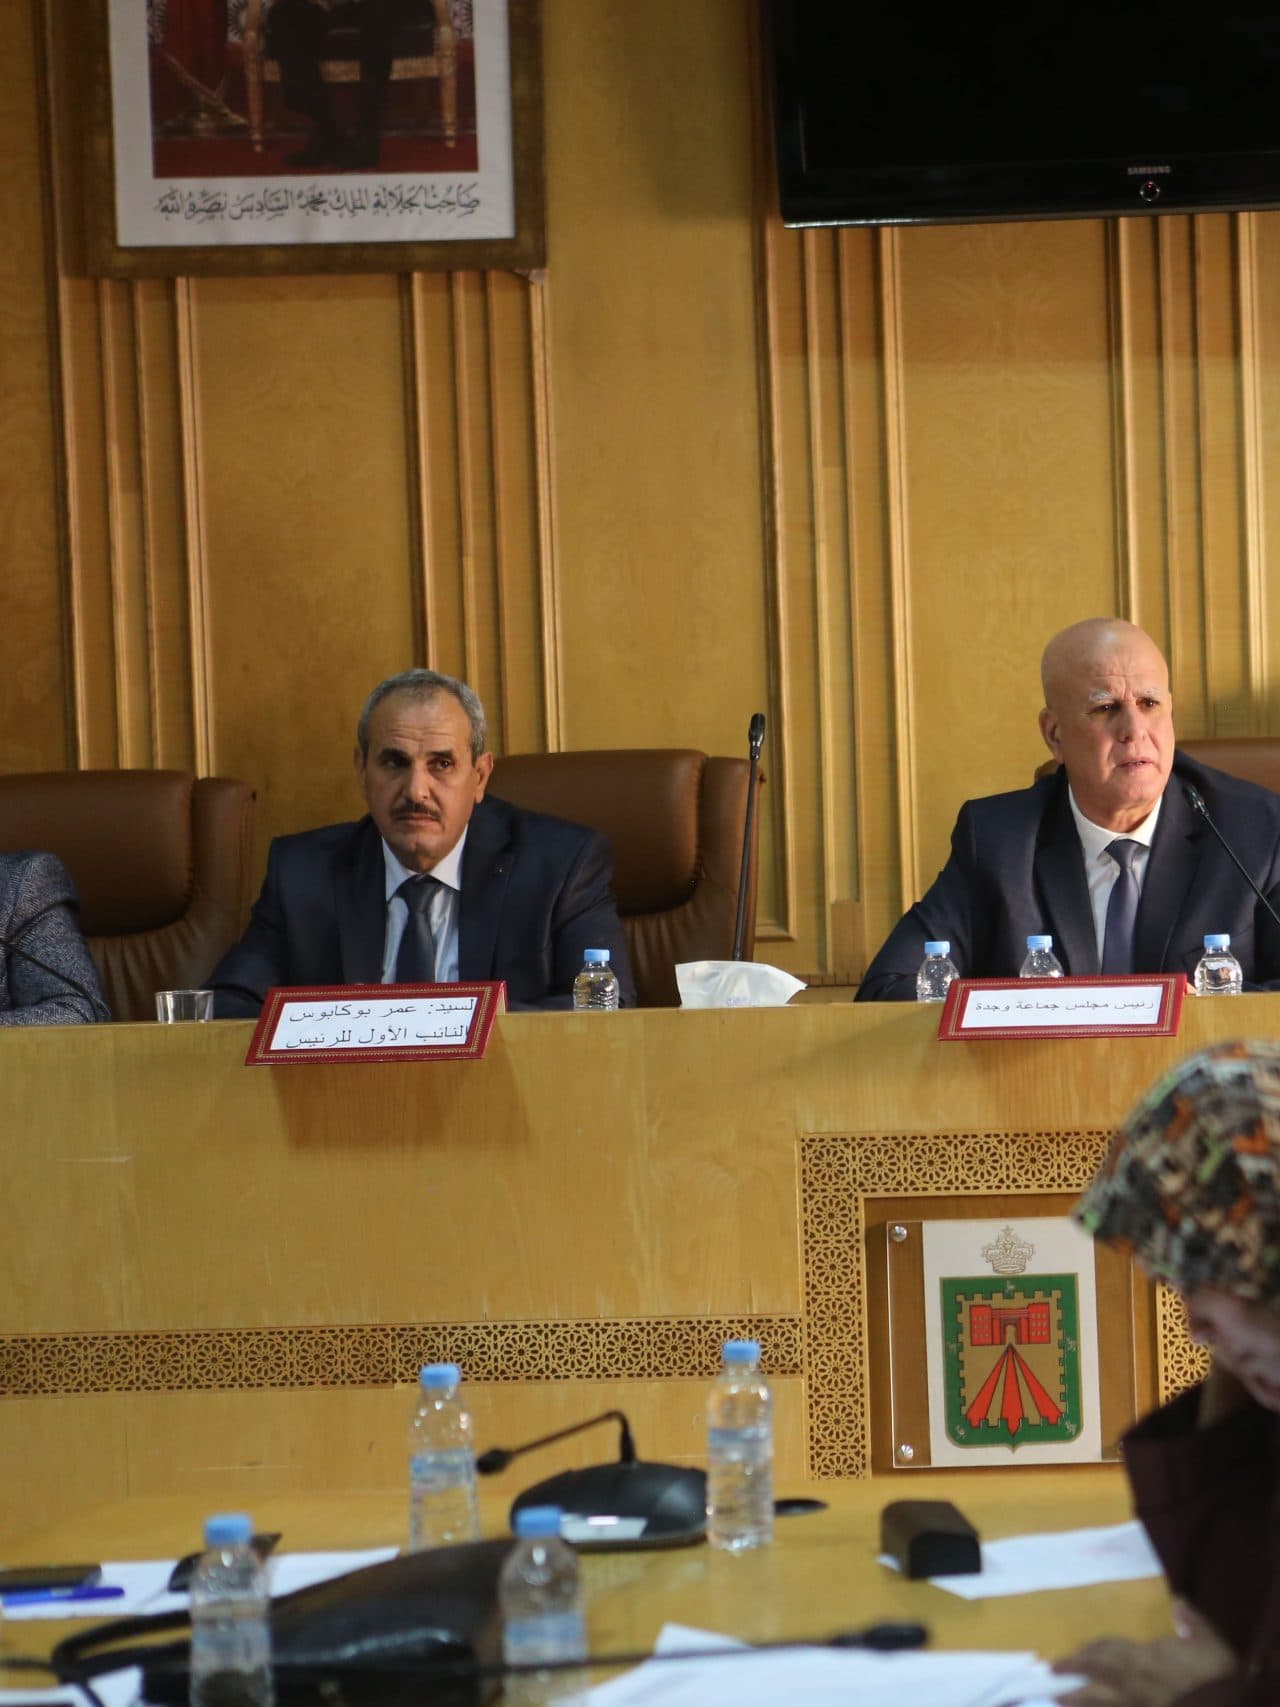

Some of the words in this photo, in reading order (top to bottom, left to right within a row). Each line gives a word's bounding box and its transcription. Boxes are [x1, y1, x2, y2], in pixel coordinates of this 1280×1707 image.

[1127, 166, 1171, 175] SAMSUNG
[429, 998, 474, 1015] لسيد:
[975, 1002, 1010, 1012] وجدة
[1015, 1001, 1060, 1011] جماعة
[1065, 1001, 1109, 1011] مجلس
[1113, 1000, 1154, 1010] رئيس
[381, 1004, 417, 1018] عمر
[286, 1029, 352, 1049] للرئيس
[358, 1027, 407, 1045] الأول
